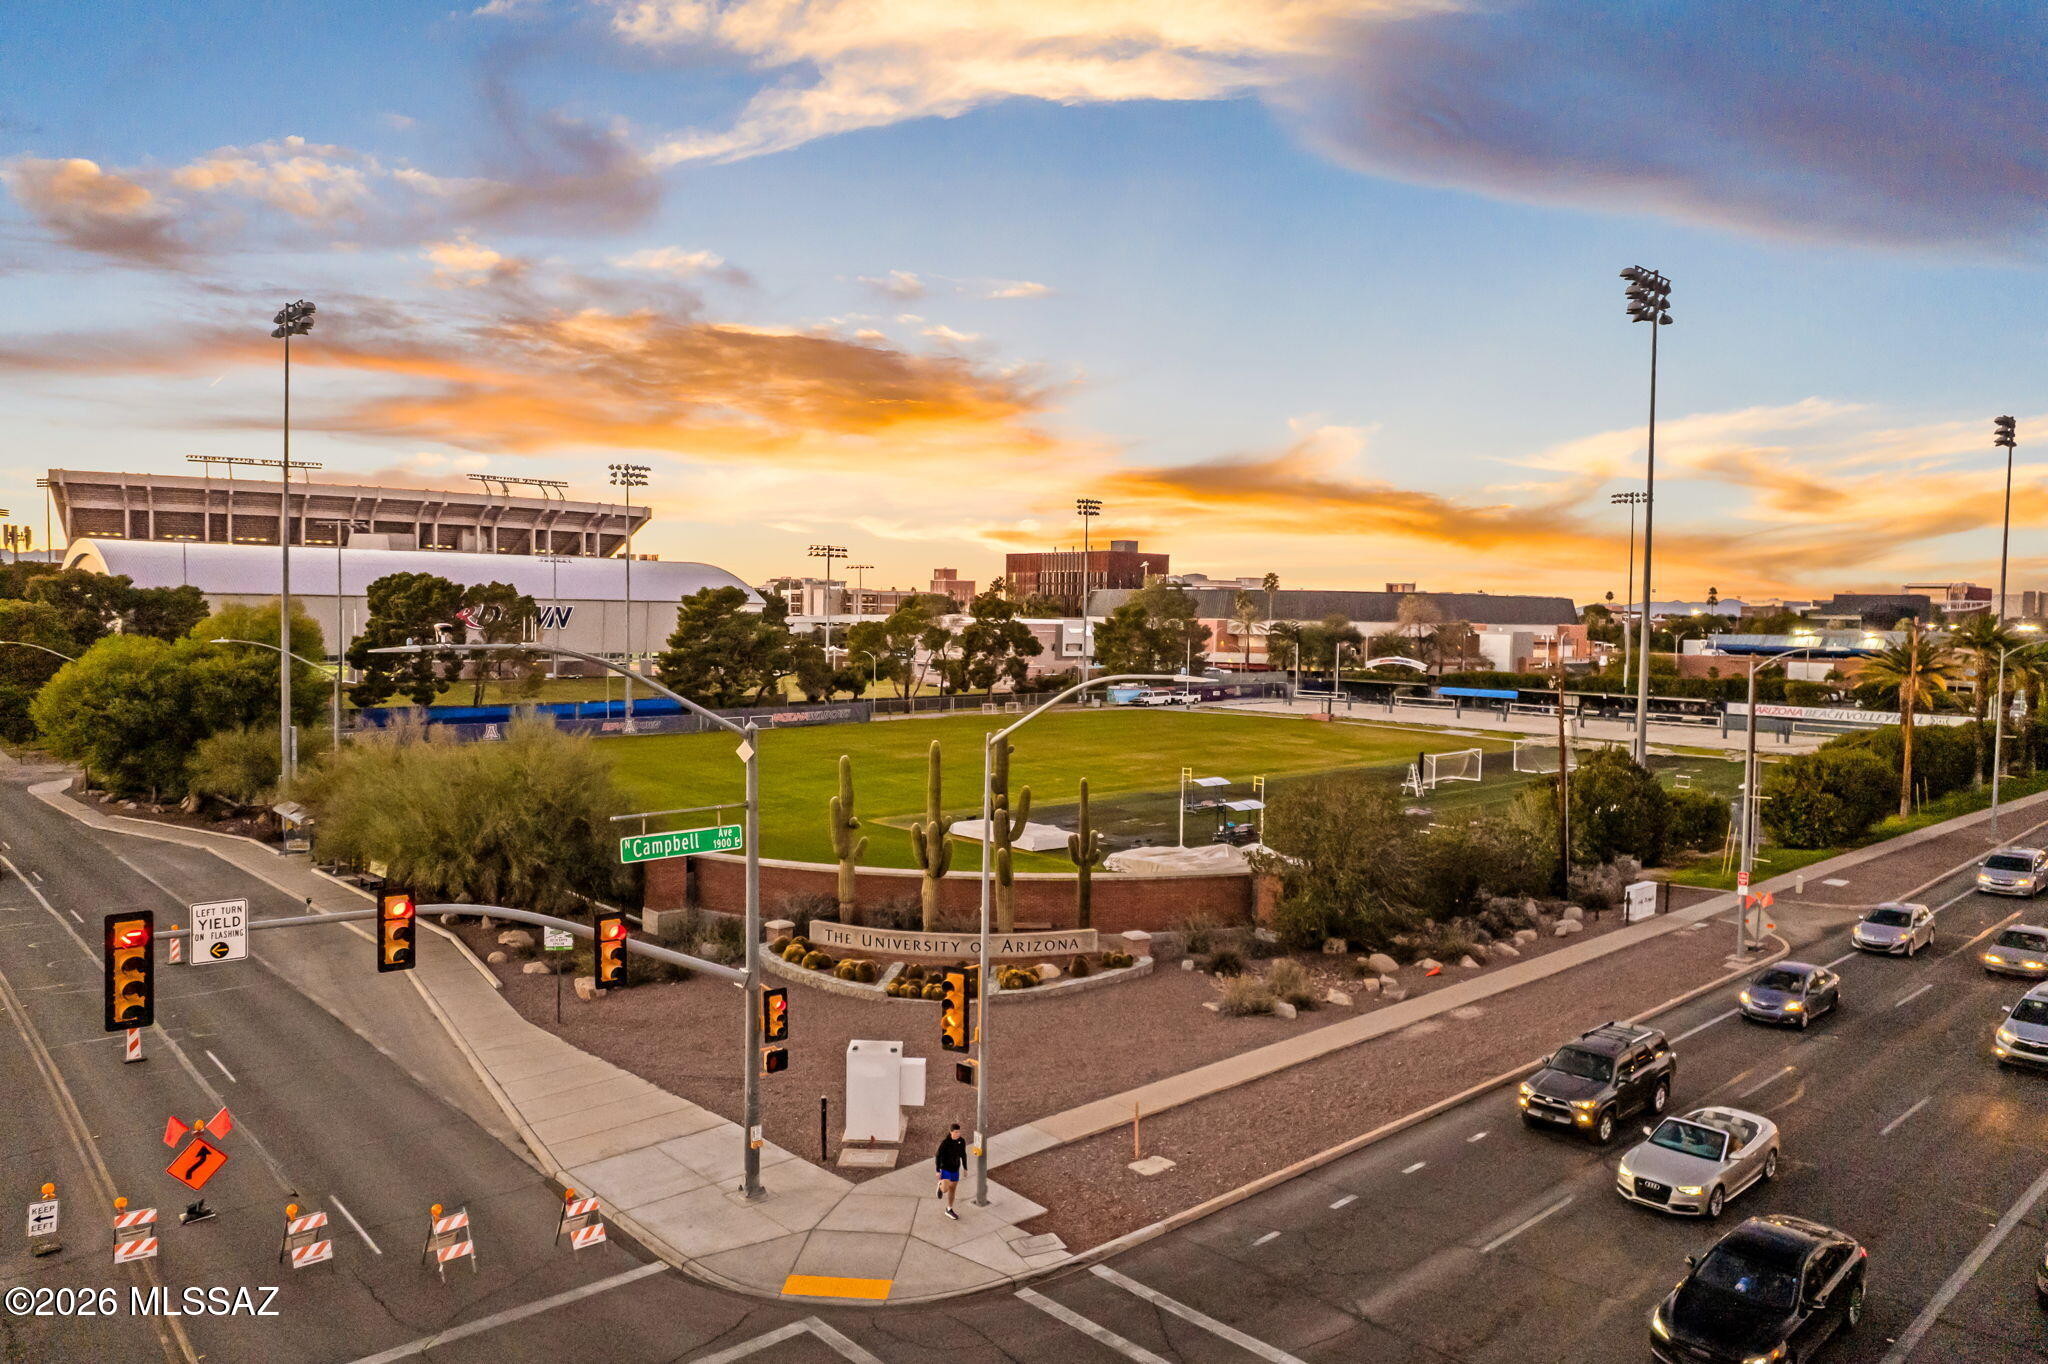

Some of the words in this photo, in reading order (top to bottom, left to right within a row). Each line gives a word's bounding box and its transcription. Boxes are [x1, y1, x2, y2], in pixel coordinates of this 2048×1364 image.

[1755, 705, 1803, 717] ARIZONA
[1804, 708, 1844, 720] BEACH
[718, 828, 733, 838] Ave
[624, 839, 631, 849] N
[632, 832, 700, 857] Campbell
[713, 837, 732, 849] 1900
[196, 908, 216, 918] LEFT
[221, 905, 242, 915] TURN
[198, 916, 241, 930] YIELD
[194, 933, 205, 941] ON
[210, 928, 244, 940] FLASHING
[825, 928, 852, 945] THE
[862, 934, 960, 953] UNIVERSITY
[1001, 938, 1079, 953] ARIZONA
[31, 1205, 55, 1216] KEEP
[31, 1221, 54, 1233] LEFT
